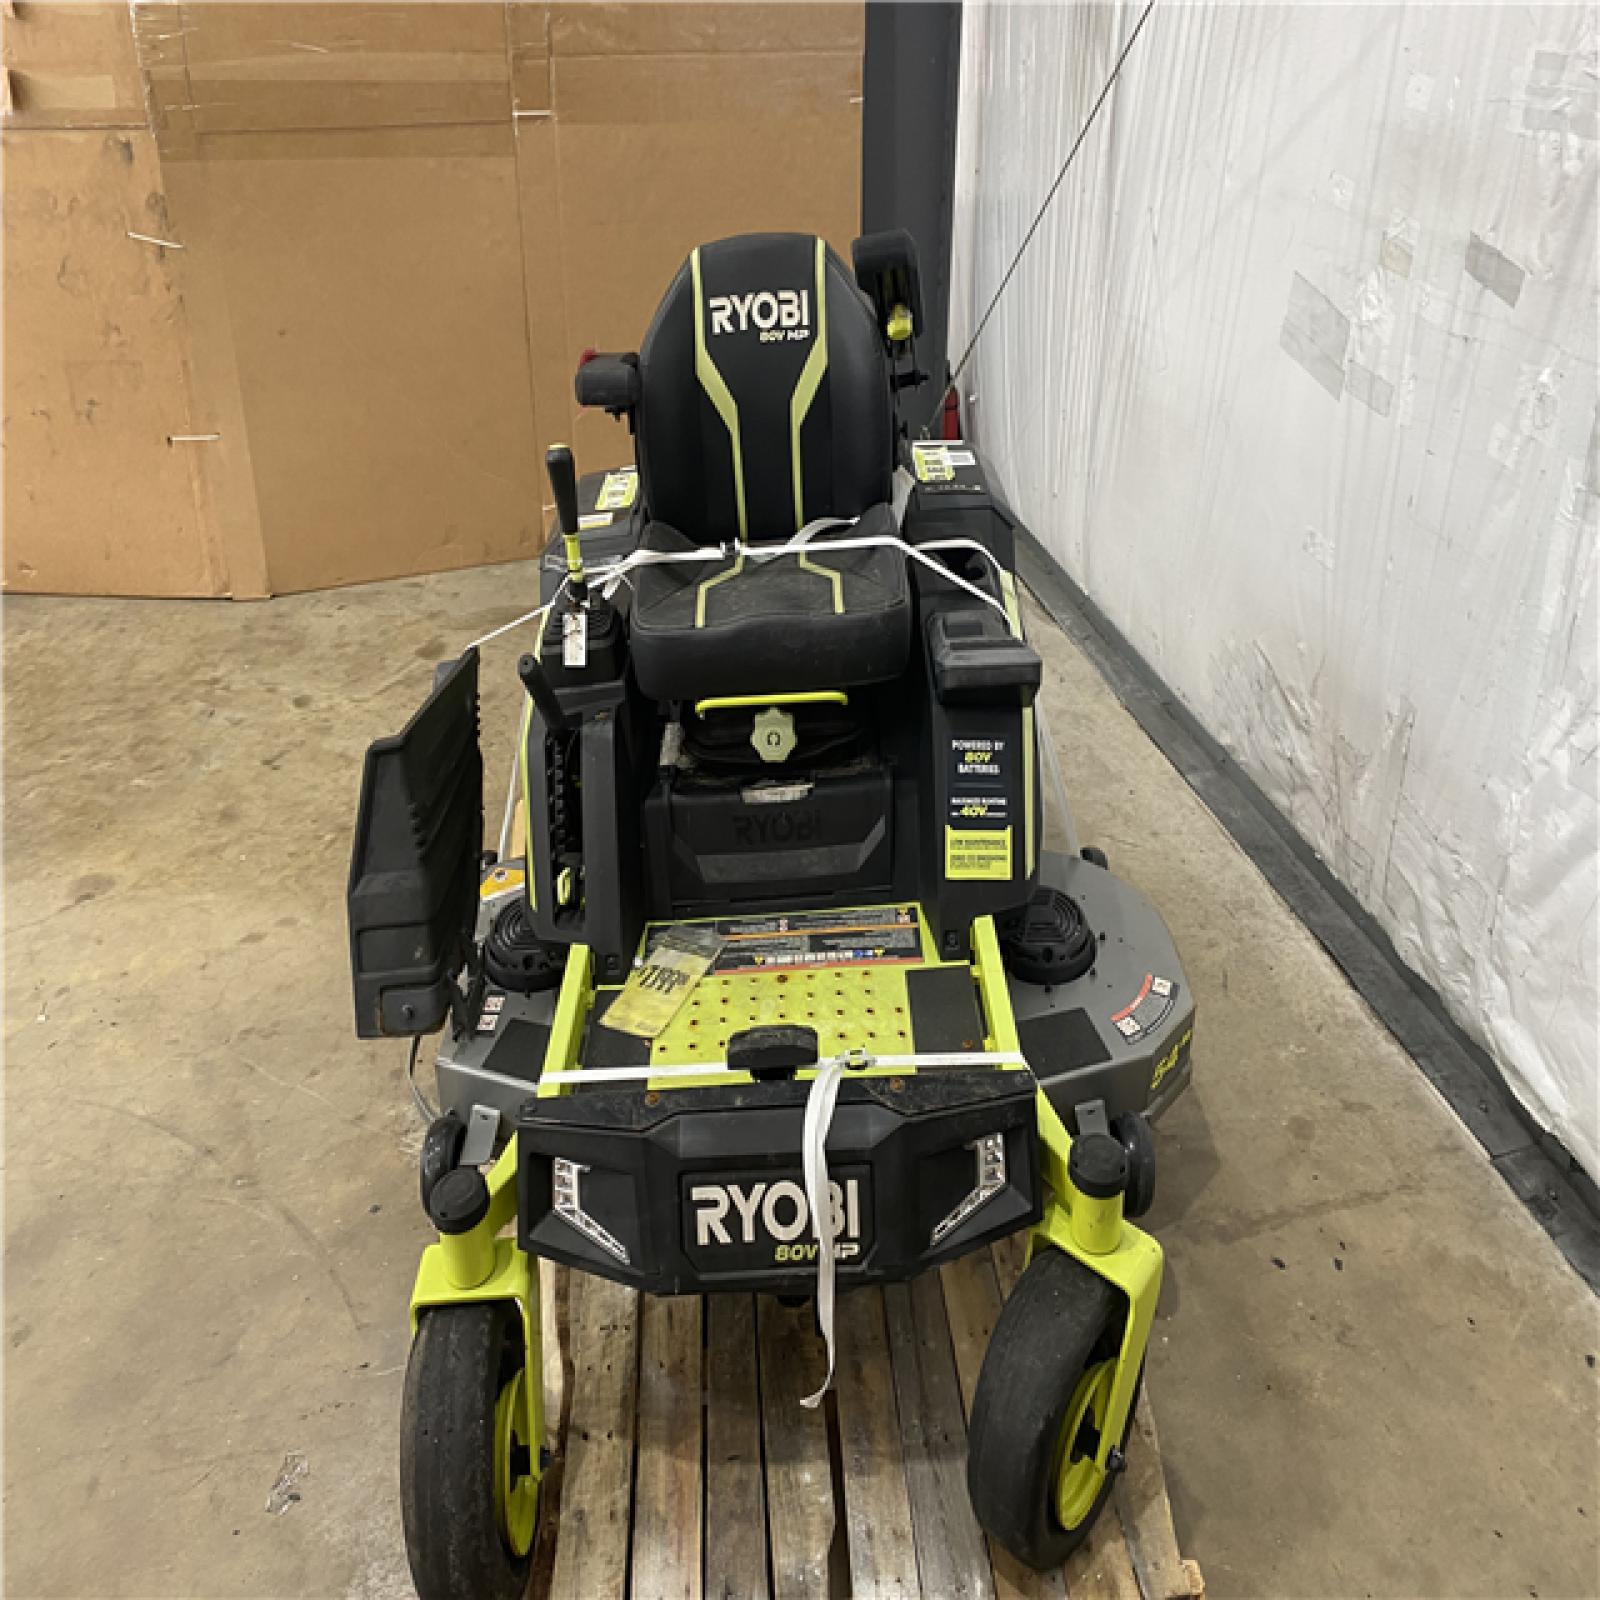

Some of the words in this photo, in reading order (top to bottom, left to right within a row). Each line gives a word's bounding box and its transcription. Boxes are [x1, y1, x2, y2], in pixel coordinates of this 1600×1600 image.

[709, 290, 810, 335] RYOBI
[732, 808, 822, 846] RYOBI
[691, 1179, 860, 1246] RYOBI
[775, 1244, 819, 1263] 80V
